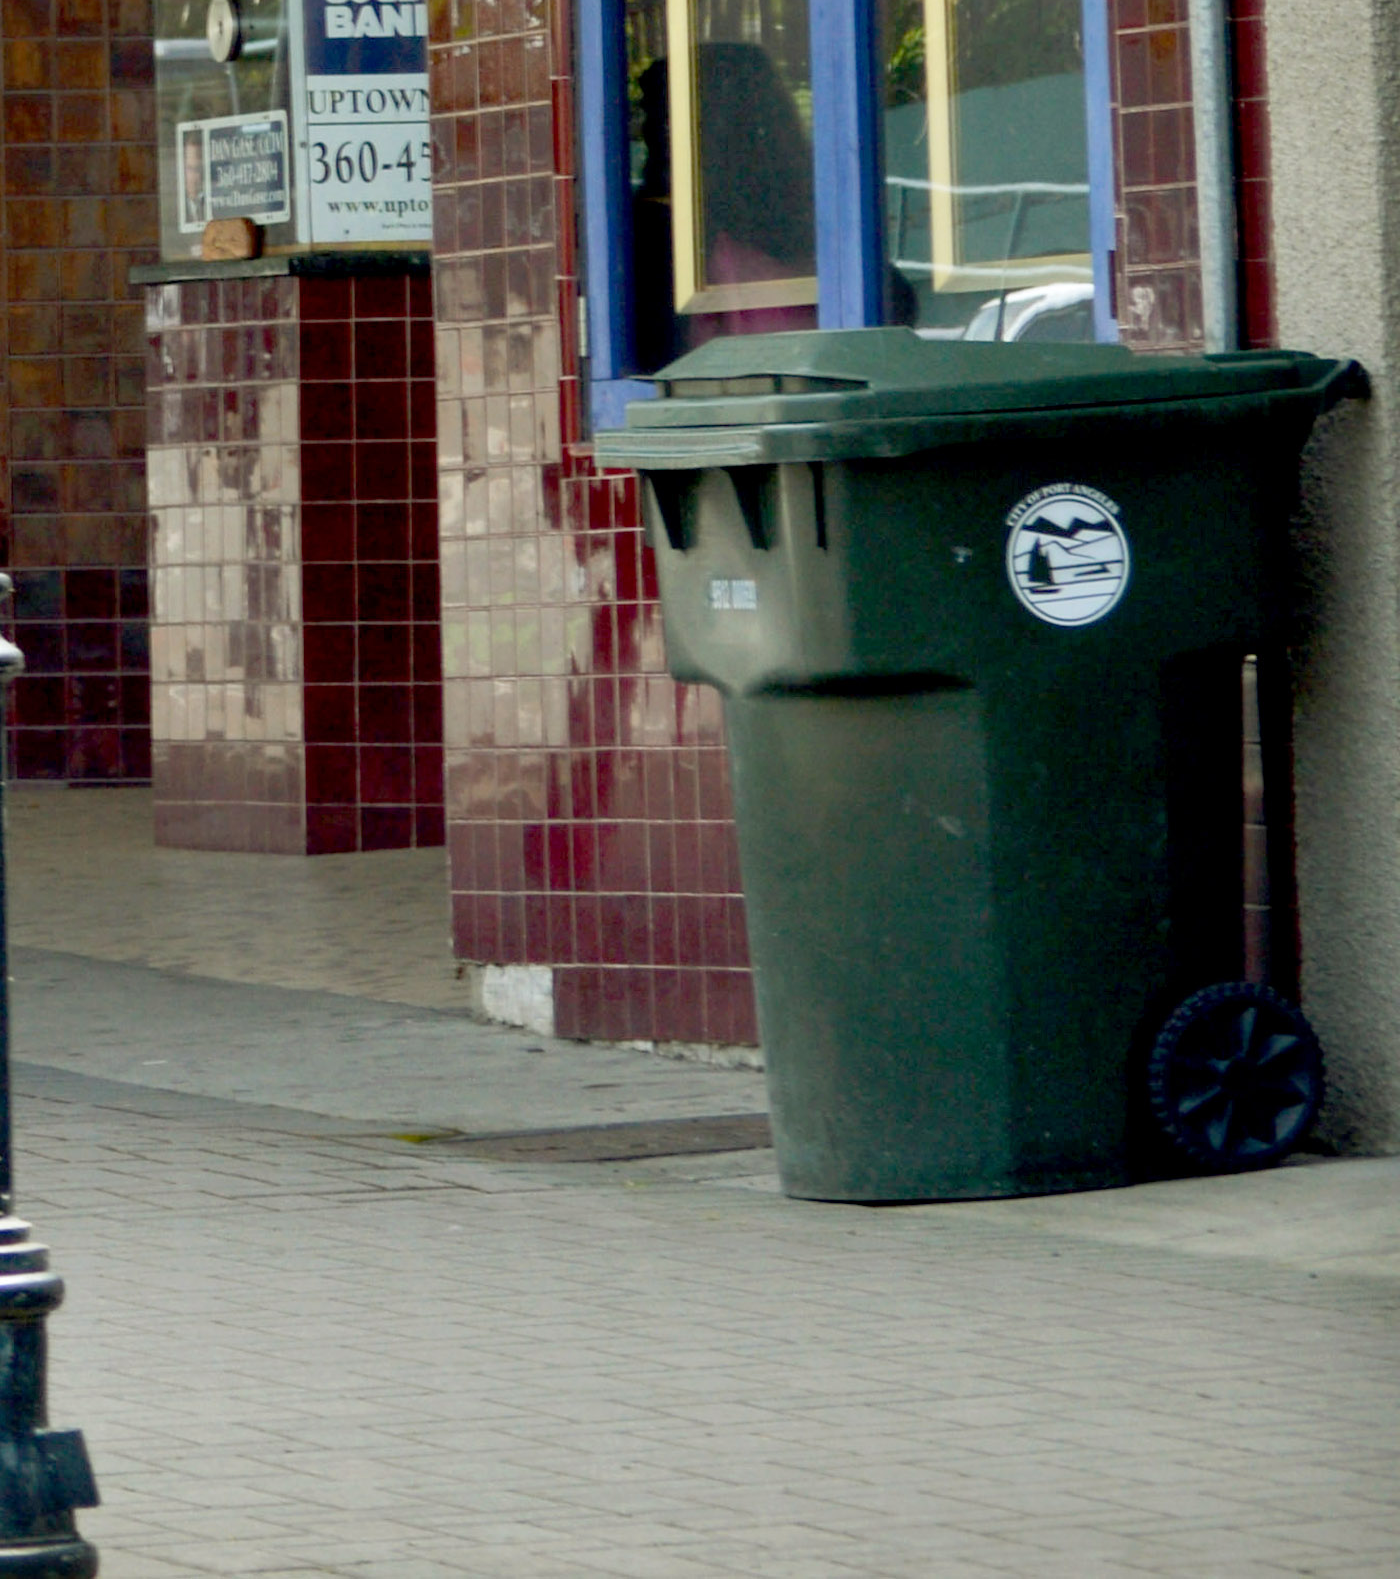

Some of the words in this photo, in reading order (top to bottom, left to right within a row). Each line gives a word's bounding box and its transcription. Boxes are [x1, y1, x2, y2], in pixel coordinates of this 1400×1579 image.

[1005, 501, 1028, 528] CITY
[1042, 482, 1073, 498] PORT
[1073, 483, 1121, 515] ANGELES
